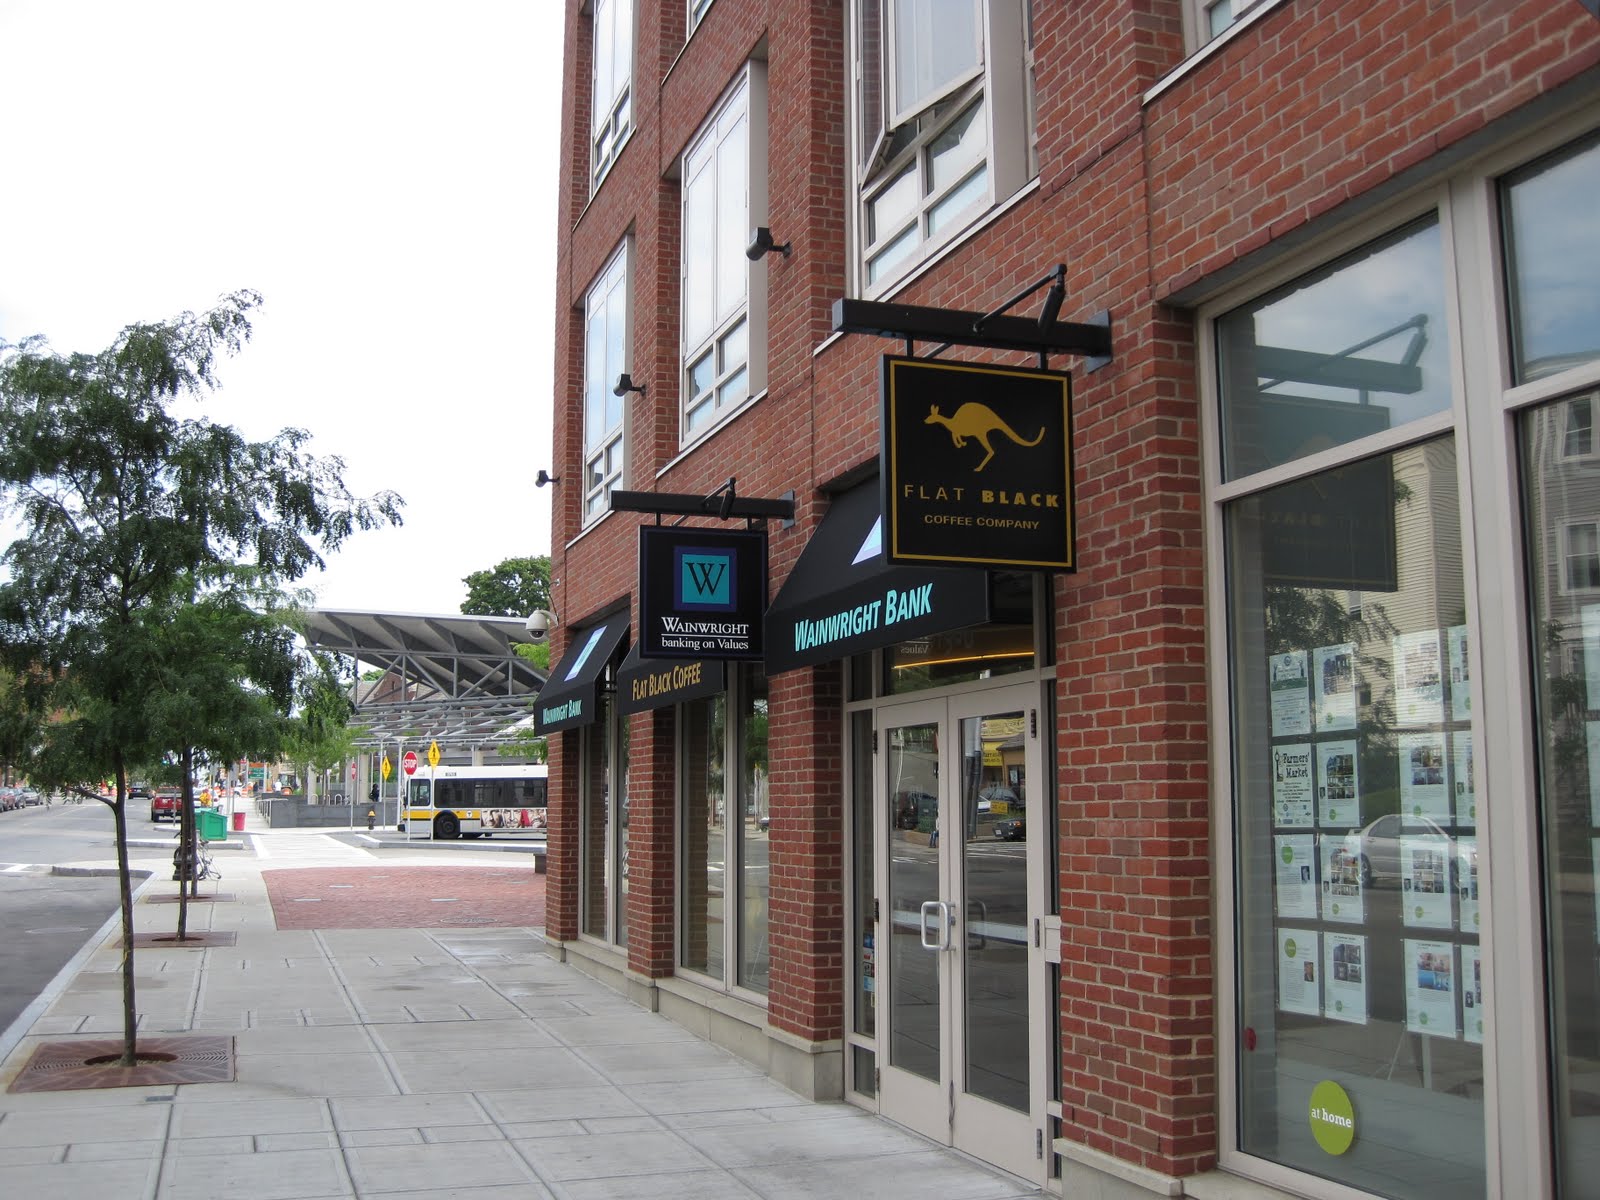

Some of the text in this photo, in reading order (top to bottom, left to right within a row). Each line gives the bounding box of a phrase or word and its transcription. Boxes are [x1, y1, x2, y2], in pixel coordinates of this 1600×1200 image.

[904, 484, 1059, 507] FLAT BLACK
[924, 514, 1040, 529] COFFEE COMPANY
[685, 562, 727, 596] W
[661, 616, 749, 634] WAINWRIGHT
[794, 582, 933, 652] WAINWRIGHT BANK
[661, 637, 749, 650] banking on Values
[632, 661, 702, 701] FLAT BLACK COFFEE
[568, 699, 582, 718] BANK
[404, 758, 417, 768] STOP
[1285, 767, 1309, 778] Market
[1311, 1107, 1352, 1128] at home
